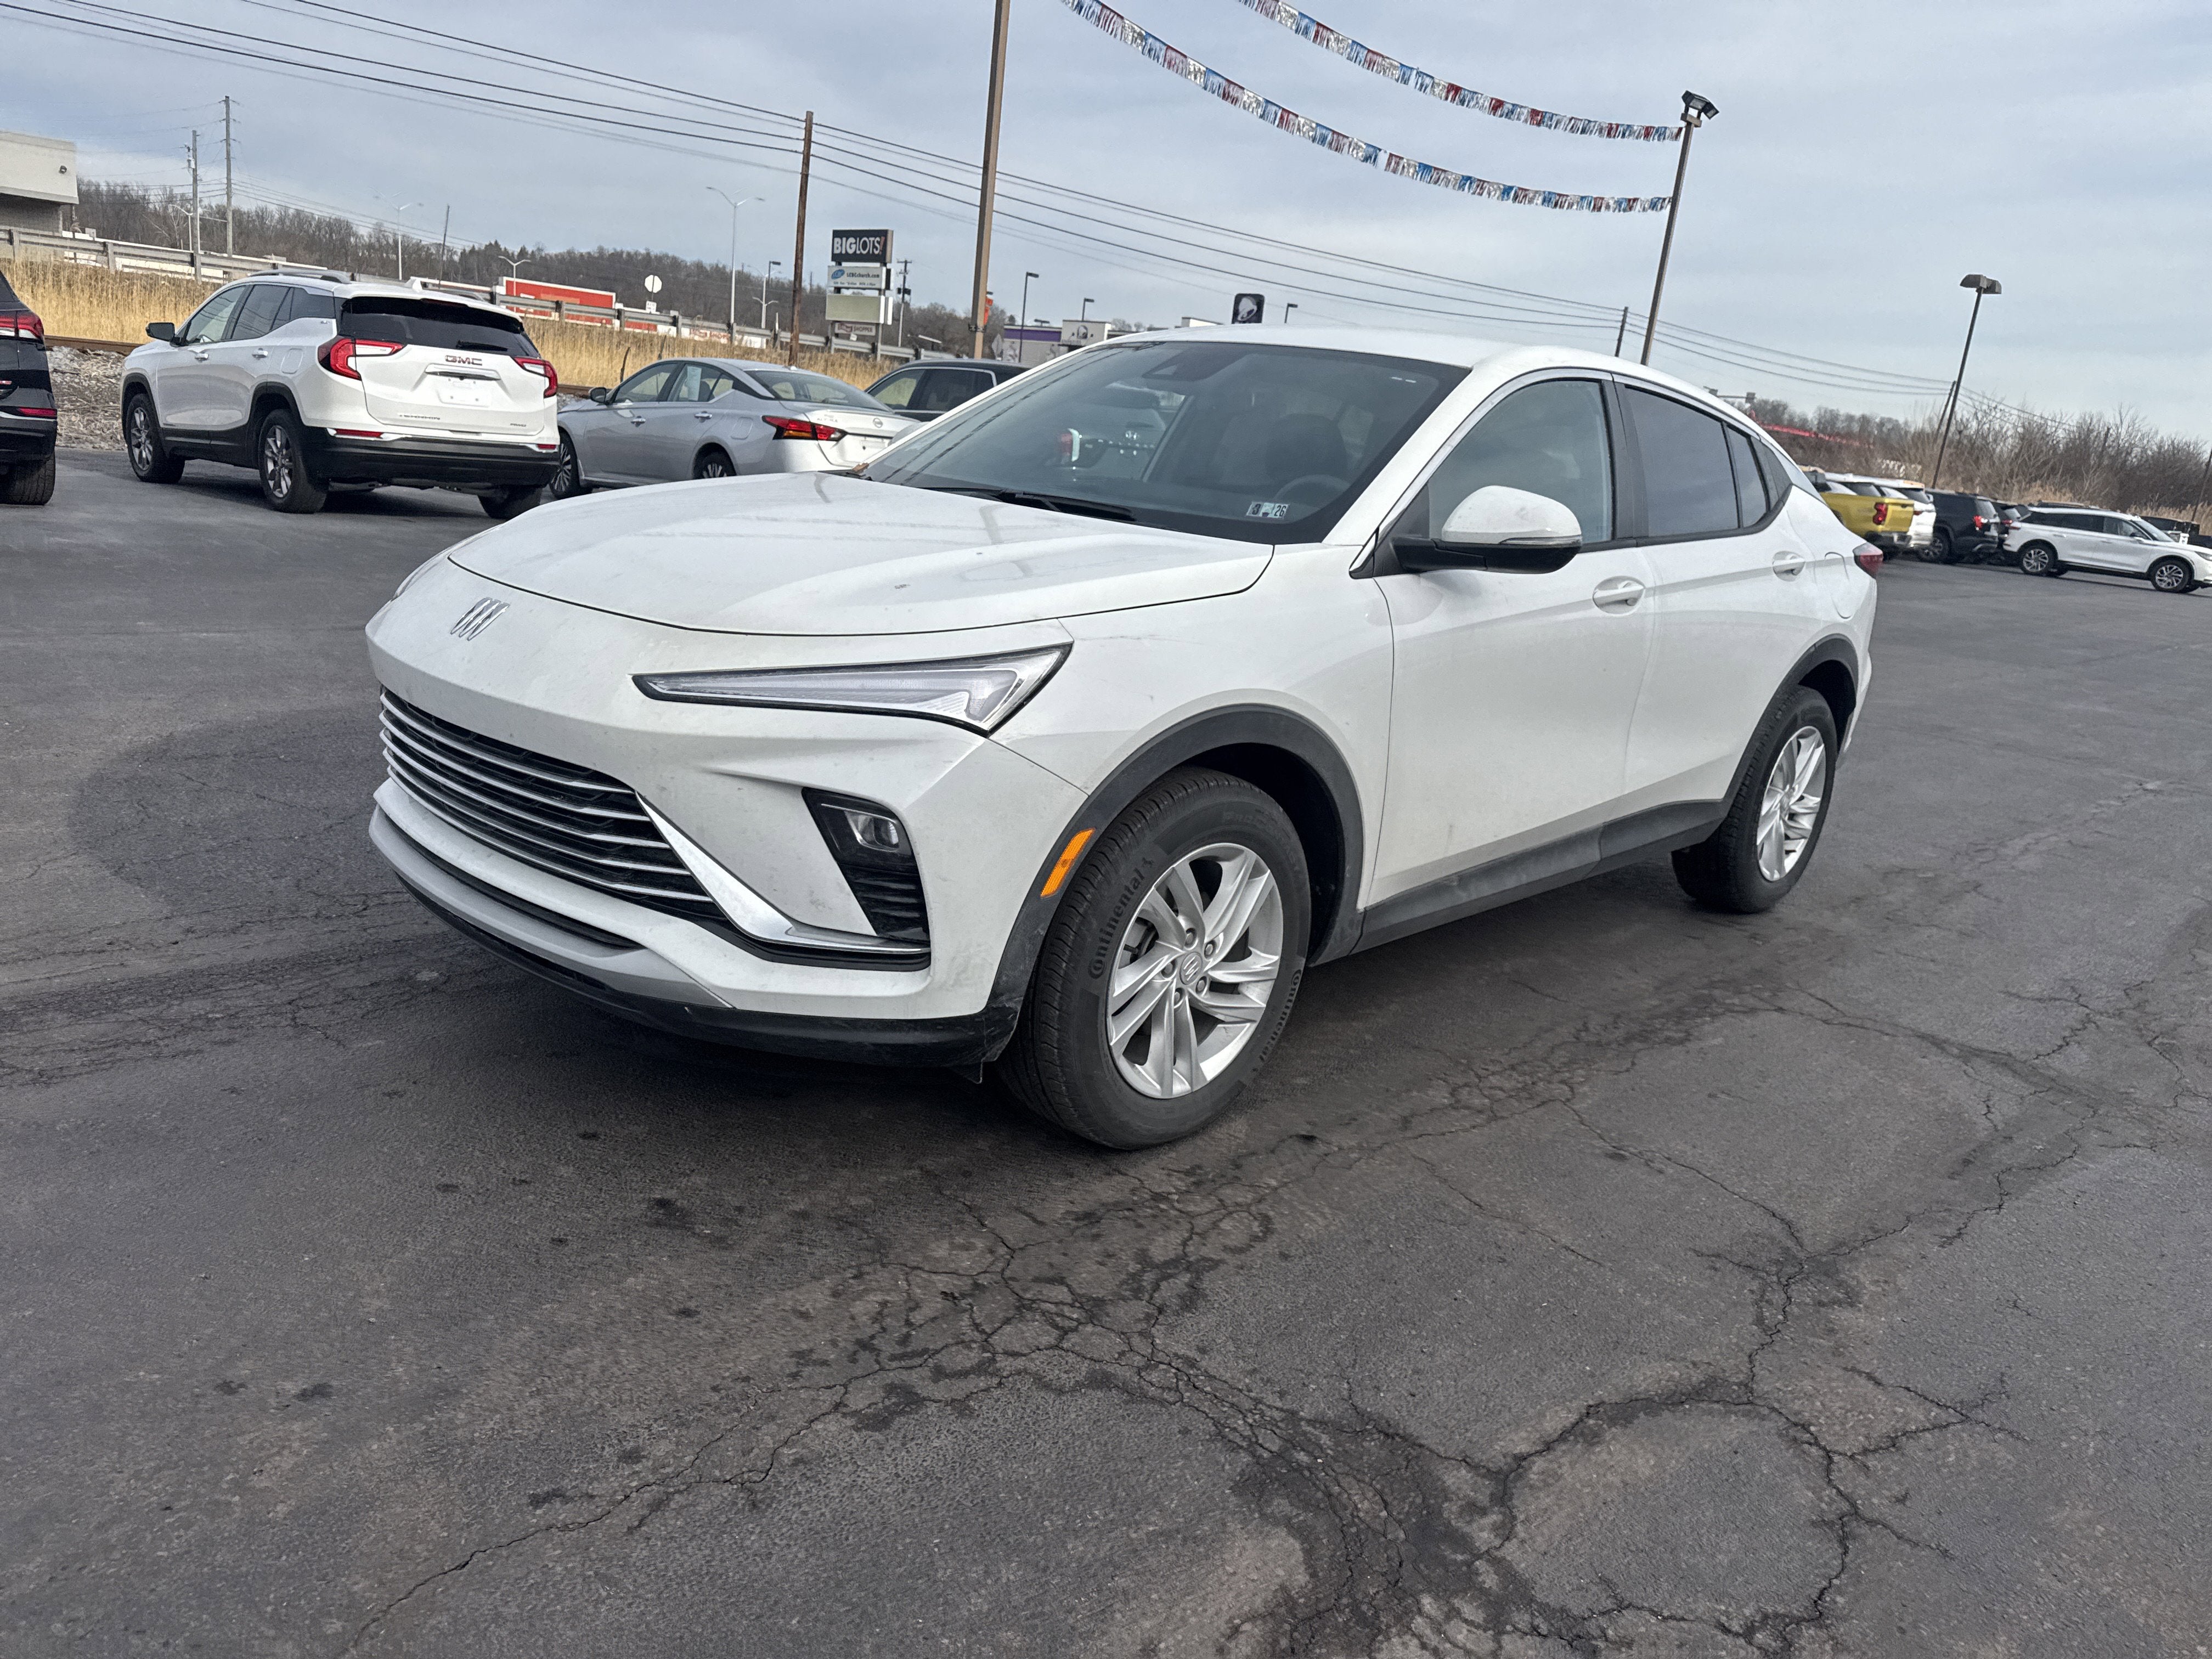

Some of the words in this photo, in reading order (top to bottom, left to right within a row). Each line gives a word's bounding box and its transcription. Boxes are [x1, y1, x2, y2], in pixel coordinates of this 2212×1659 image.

[445, 355, 482, 366] GMC
[1252, 504, 1261, 515] 3
[1274, 505, 1286, 517] 26
[1088, 867, 1145, 979] Continental
